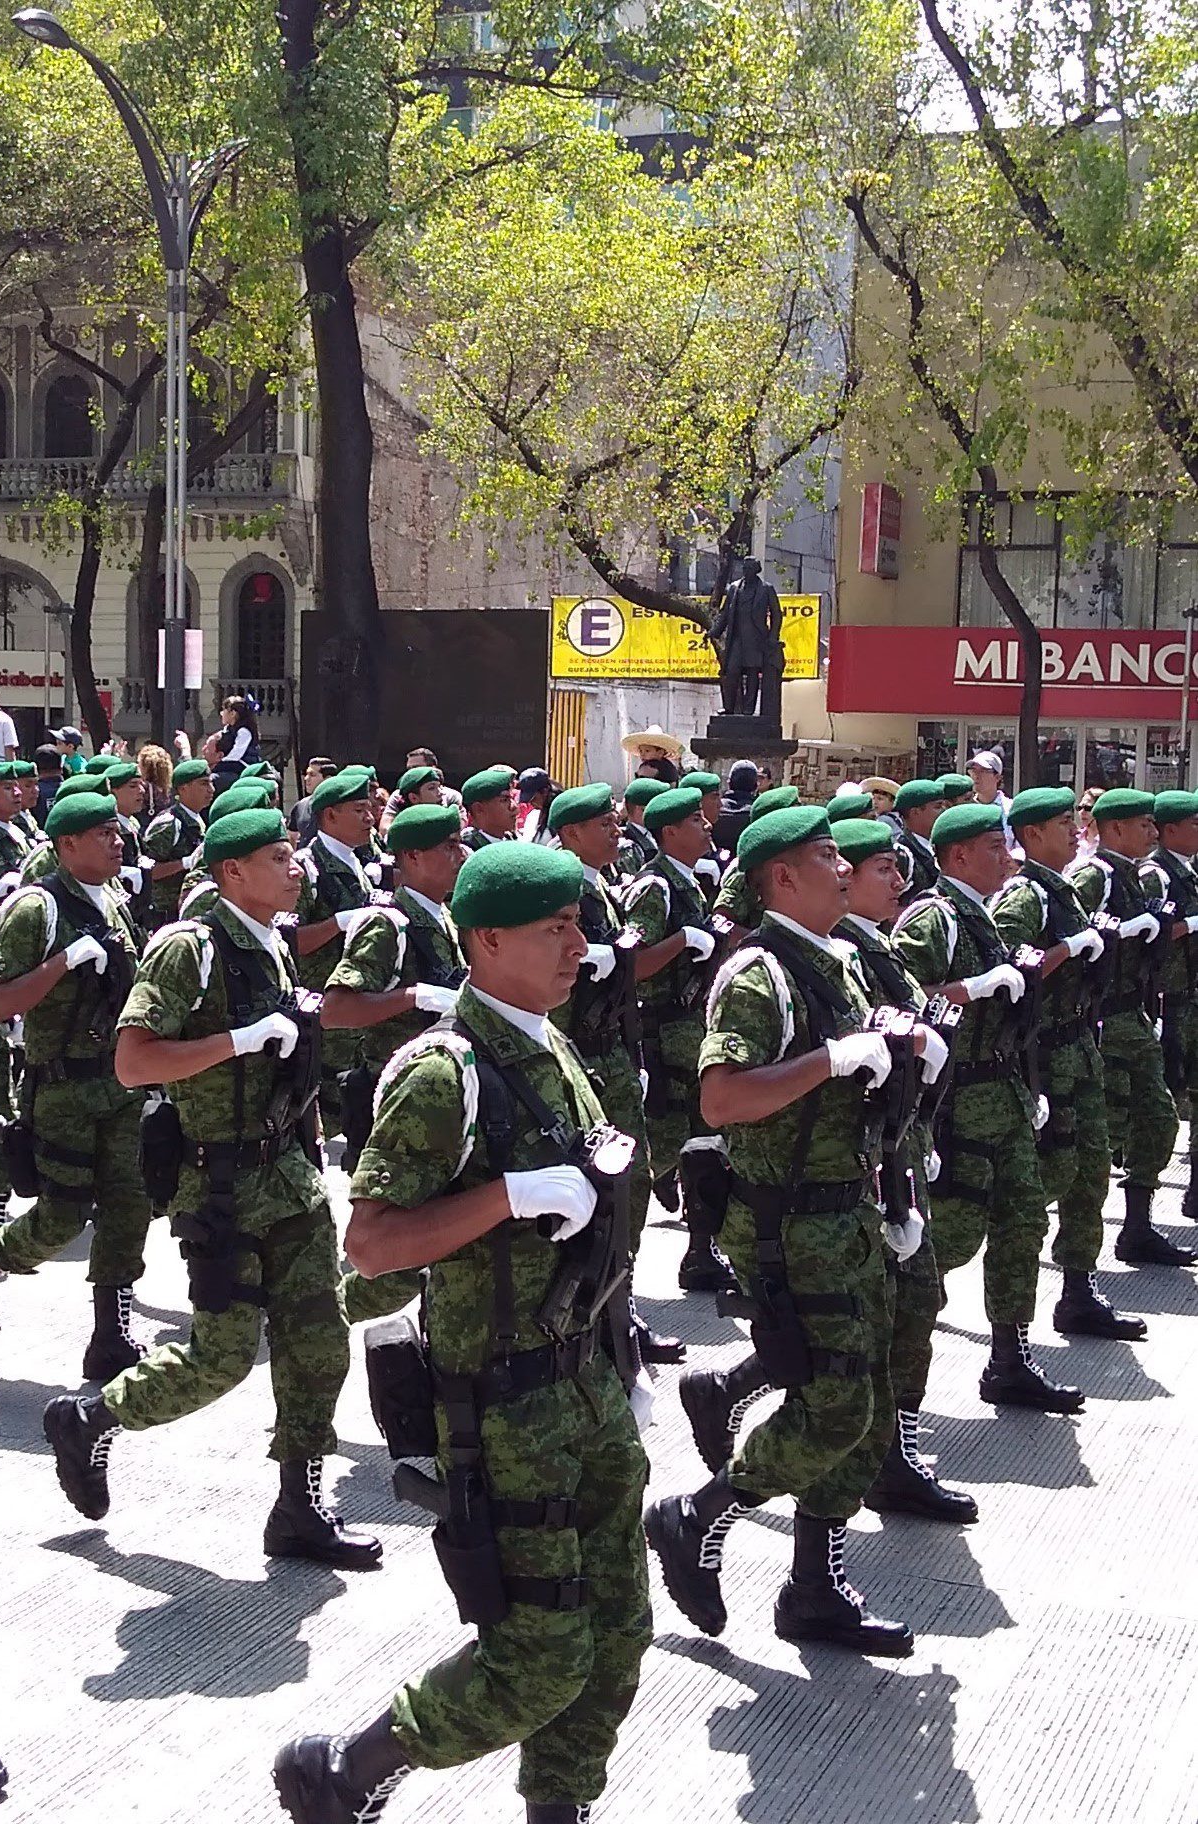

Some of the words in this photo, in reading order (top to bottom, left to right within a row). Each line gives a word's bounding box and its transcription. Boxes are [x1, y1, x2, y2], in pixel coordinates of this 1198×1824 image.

[580, 608, 612, 646] E
[955, 640, 1019, 680] MI
[1042, 642, 1198, 685] BANC
